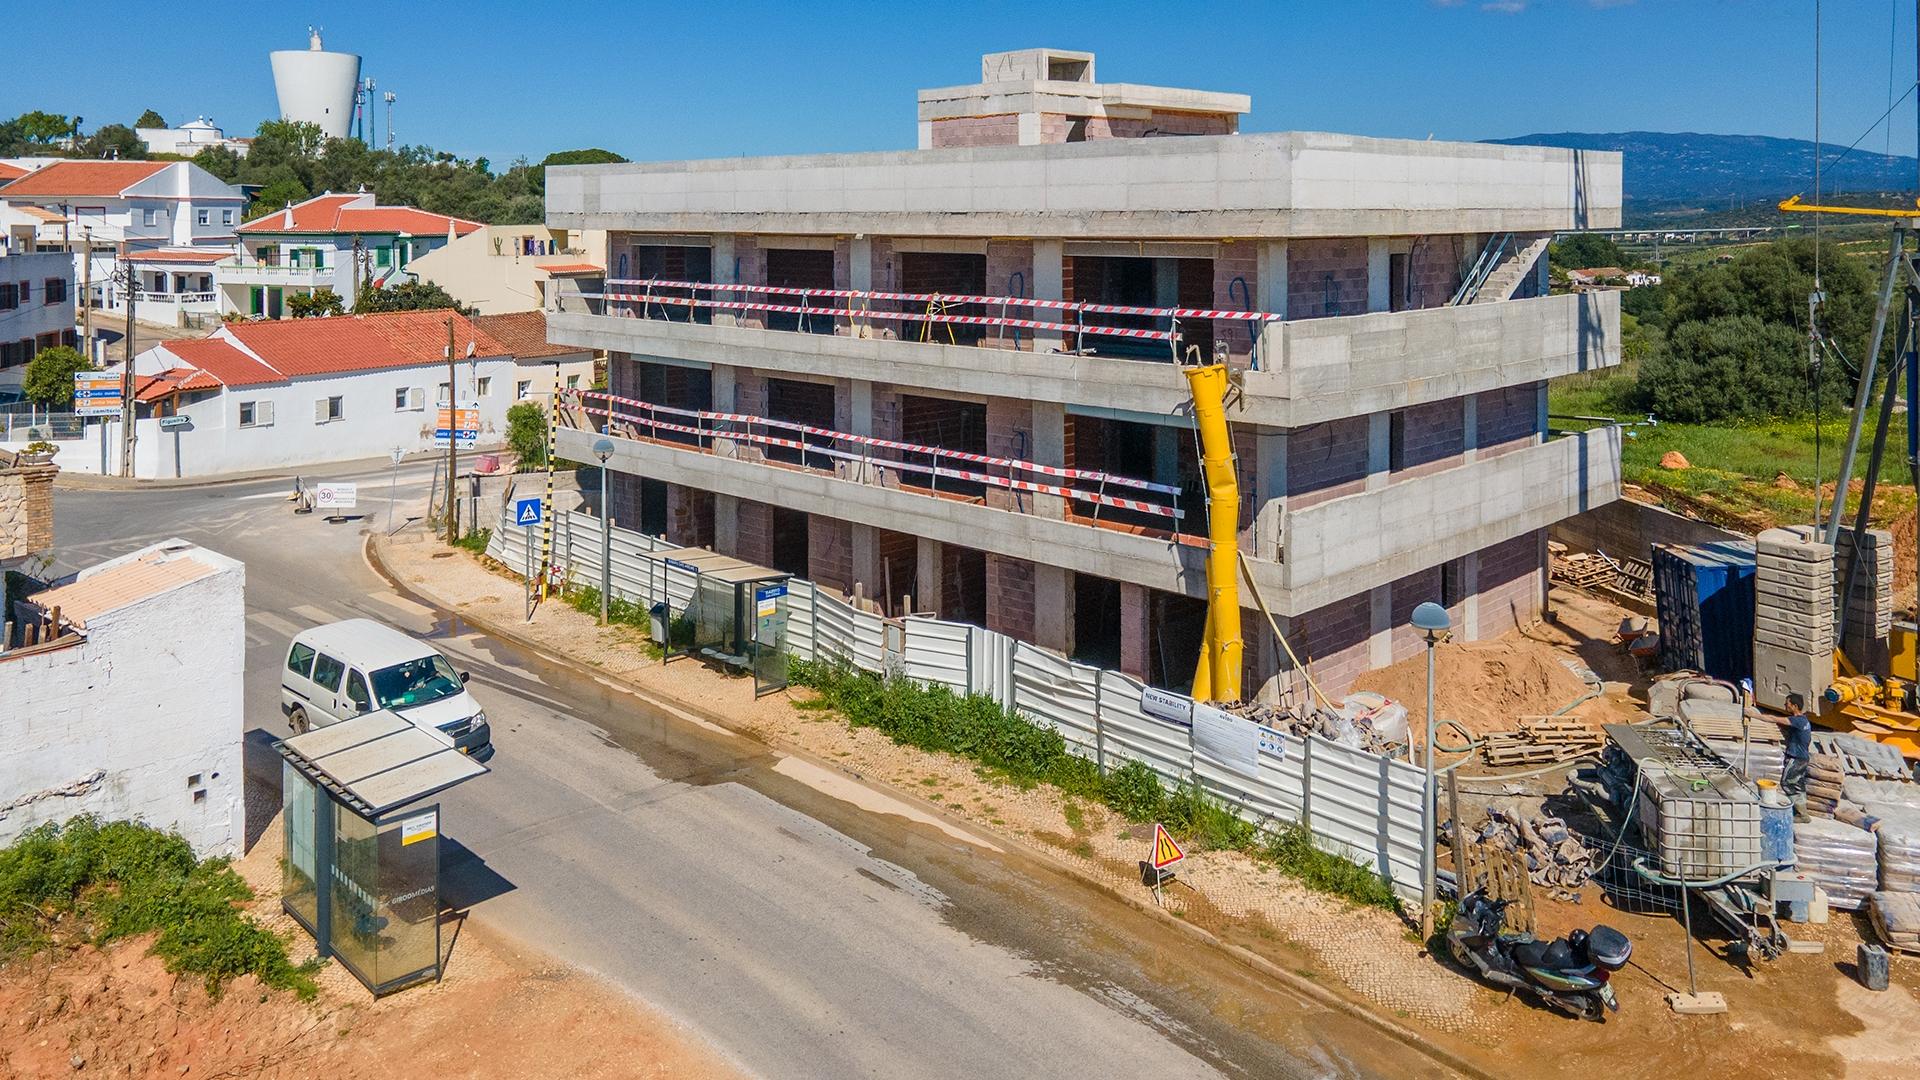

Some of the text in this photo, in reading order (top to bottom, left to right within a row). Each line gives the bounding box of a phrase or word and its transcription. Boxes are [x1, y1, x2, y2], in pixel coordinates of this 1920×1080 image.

[321, 491, 332, 500] 30
[1145, 692, 1187, 710] NEW STABILITY
